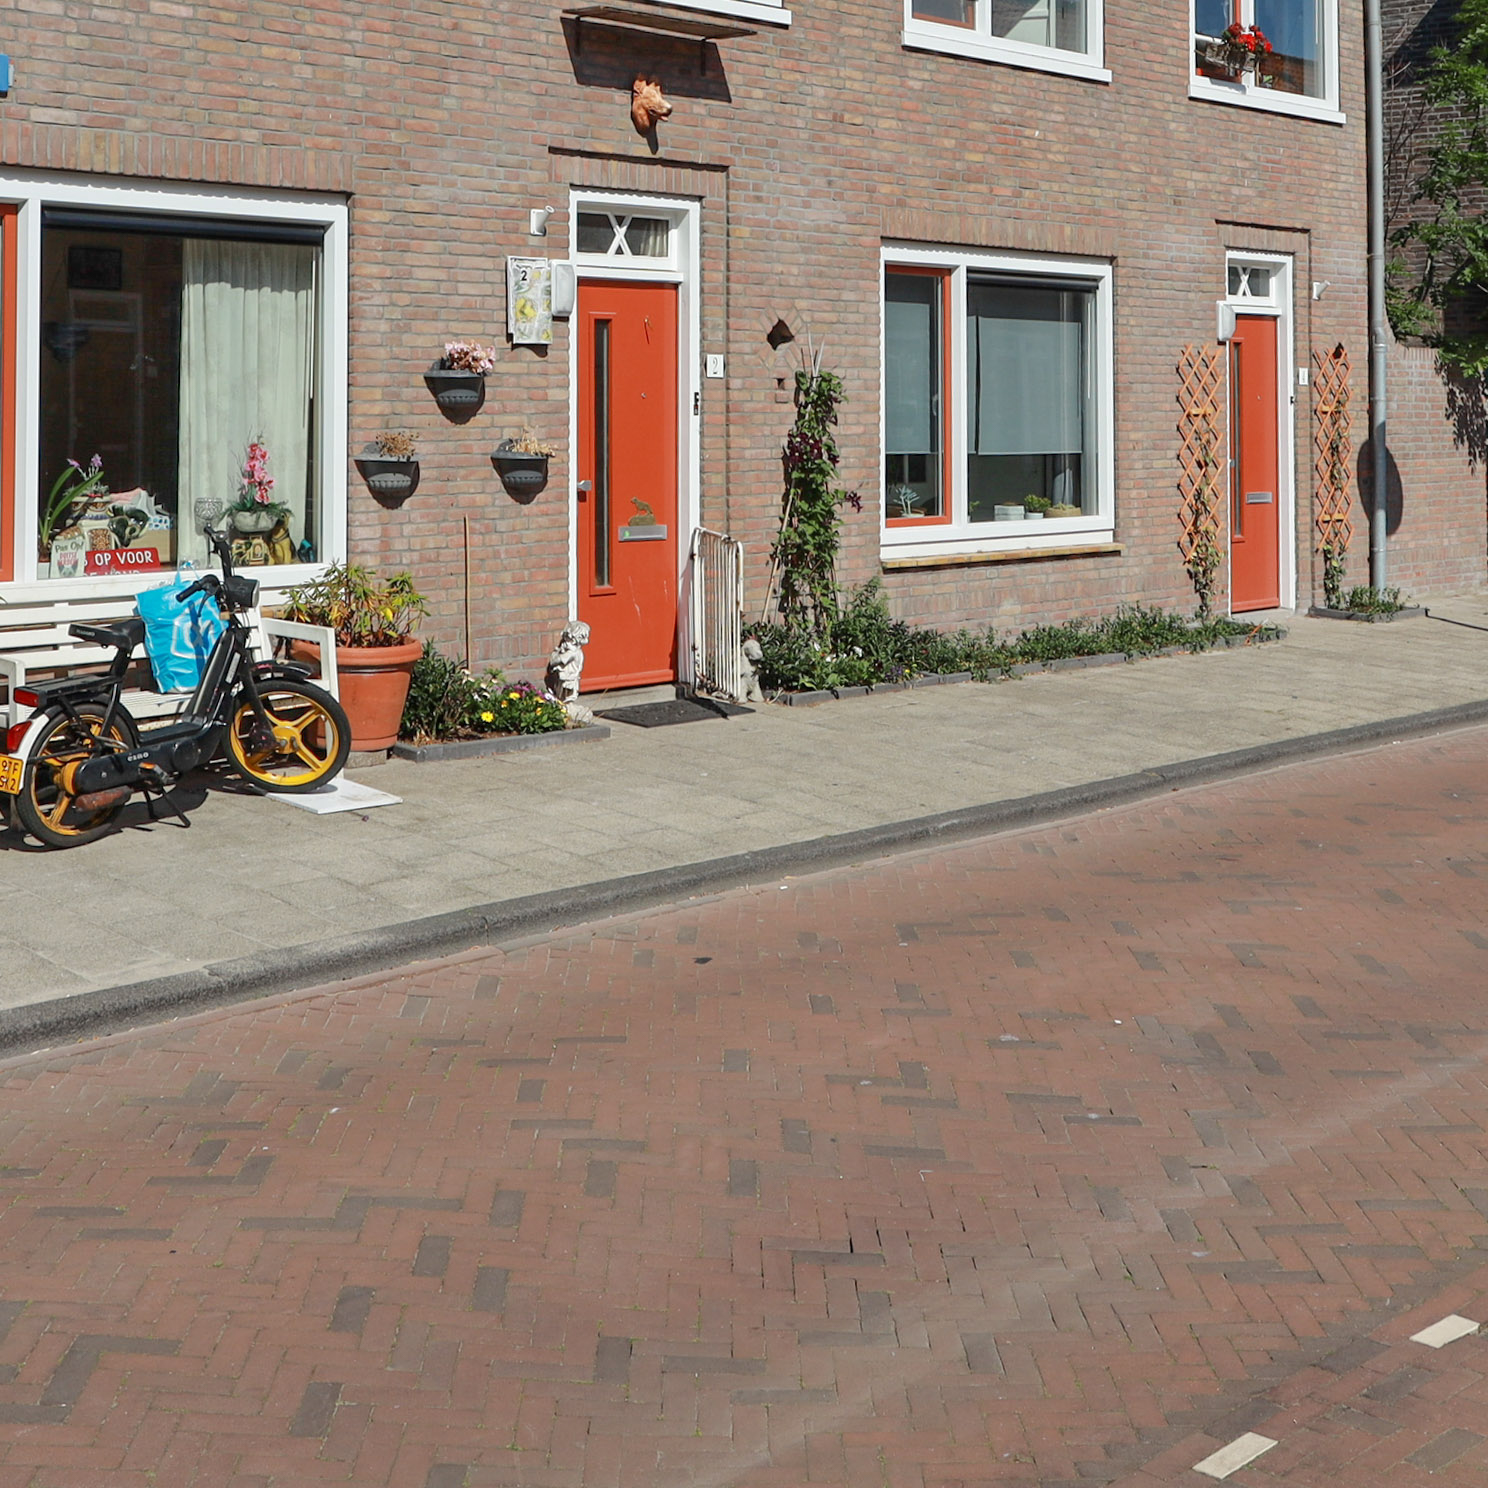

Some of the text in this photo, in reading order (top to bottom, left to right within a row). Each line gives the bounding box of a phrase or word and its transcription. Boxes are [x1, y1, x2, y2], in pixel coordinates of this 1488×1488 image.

[520, 270, 528, 281] 2
[712, 356, 719, 375] 2
[94, 552, 112, 567] OP
[115, 550, 154, 565] VOOR
